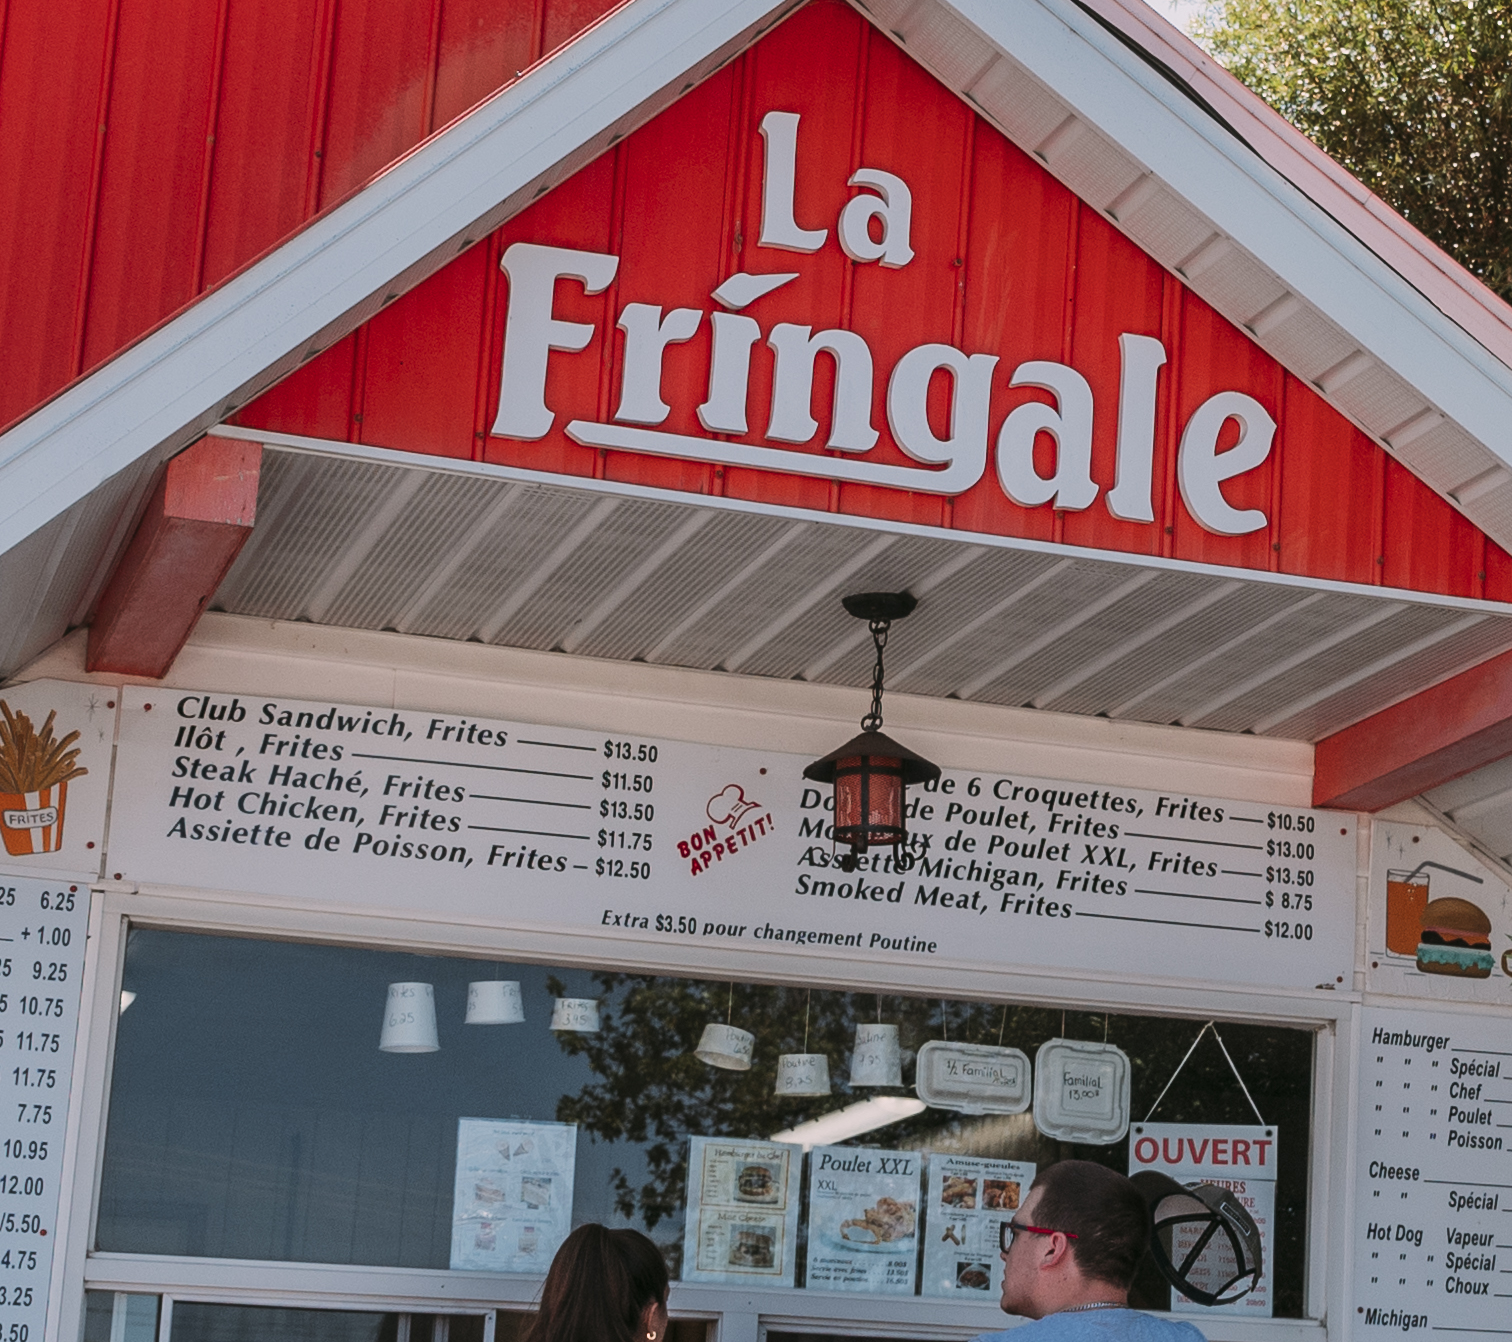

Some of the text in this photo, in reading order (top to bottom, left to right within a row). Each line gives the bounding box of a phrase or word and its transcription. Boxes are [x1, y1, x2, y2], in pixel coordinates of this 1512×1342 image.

[758, 111, 915, 268] La
[177, 696, 658, 763] Club Sandwich, Frites $13.50
[259, 734, 344, 761] Frites
[602, 770, 653, 793] $11.50
[172, 756, 654, 821] Steak Haché, Frites $13.50
[9, 811, 54, 825] FRITES
[968, 777, 981, 797] 6
[993, 779, 1143, 818] Croquettes,
[1155, 797, 1224, 823] Frites
[1268, 811, 1314, 833] $10.50
[677, 825, 717, 858] BON
[945, 802, 1035, 834] Poulet,
[1048, 813, 1119, 839] Frites
[1267, 839, 1314, 860] $13.00
[167, 817, 650, 879] Assiette de Poisson, Frites $12.50
[691, 813, 774, 876] APPETIT!
[945, 830, 976, 853] de
[987, 835, 1070, 866] Poulet
[1081, 844, 1136, 873] XXL,
[1148, 851, 1217, 877] Frites
[1266, 866, 1314, 886] $13.50
[919, 857, 1043, 891] Michigan,
[1056, 870, 1127, 895] Frites
[41, 890, 75, 912] 6.25
[795, 874, 1312, 940] Smoked Meat, Frites $12.00
[38, 926, 71, 946] 1.00
[602, 910, 937, 953] Extra $3.50 pour changement Poutine
[33, 961, 67, 982] 9.25
[1372, 1027, 1450, 1053] Hamburger
[1450, 1058, 1500, 1079] Spécial
[1450, 1082, 1482, 1100] Chef
[18, 1104, 52, 1124] 7.75
[1448, 1106, 1492, 1125] Poulet
[947, 1158, 1020, 1170] Amuse-gueules
[1135, 1137, 1272, 1166] OUVERT
[819, 1154, 913, 1176] Poulet XXL
[1369, 1161, 1419, 1181] Cheese
[0, 1175, 43, 1196] 12.00
[817, 1179, 837, 1191] XXL
[1367, 1223, 1391, 1240] Hot
[1395, 1224, 1423, 1247] Dog
[1447, 1228, 1494, 1249] Vapeur
[1, 1250, 36, 1270] 4.75
[1365, 1308, 1427, 1331] Michigan
